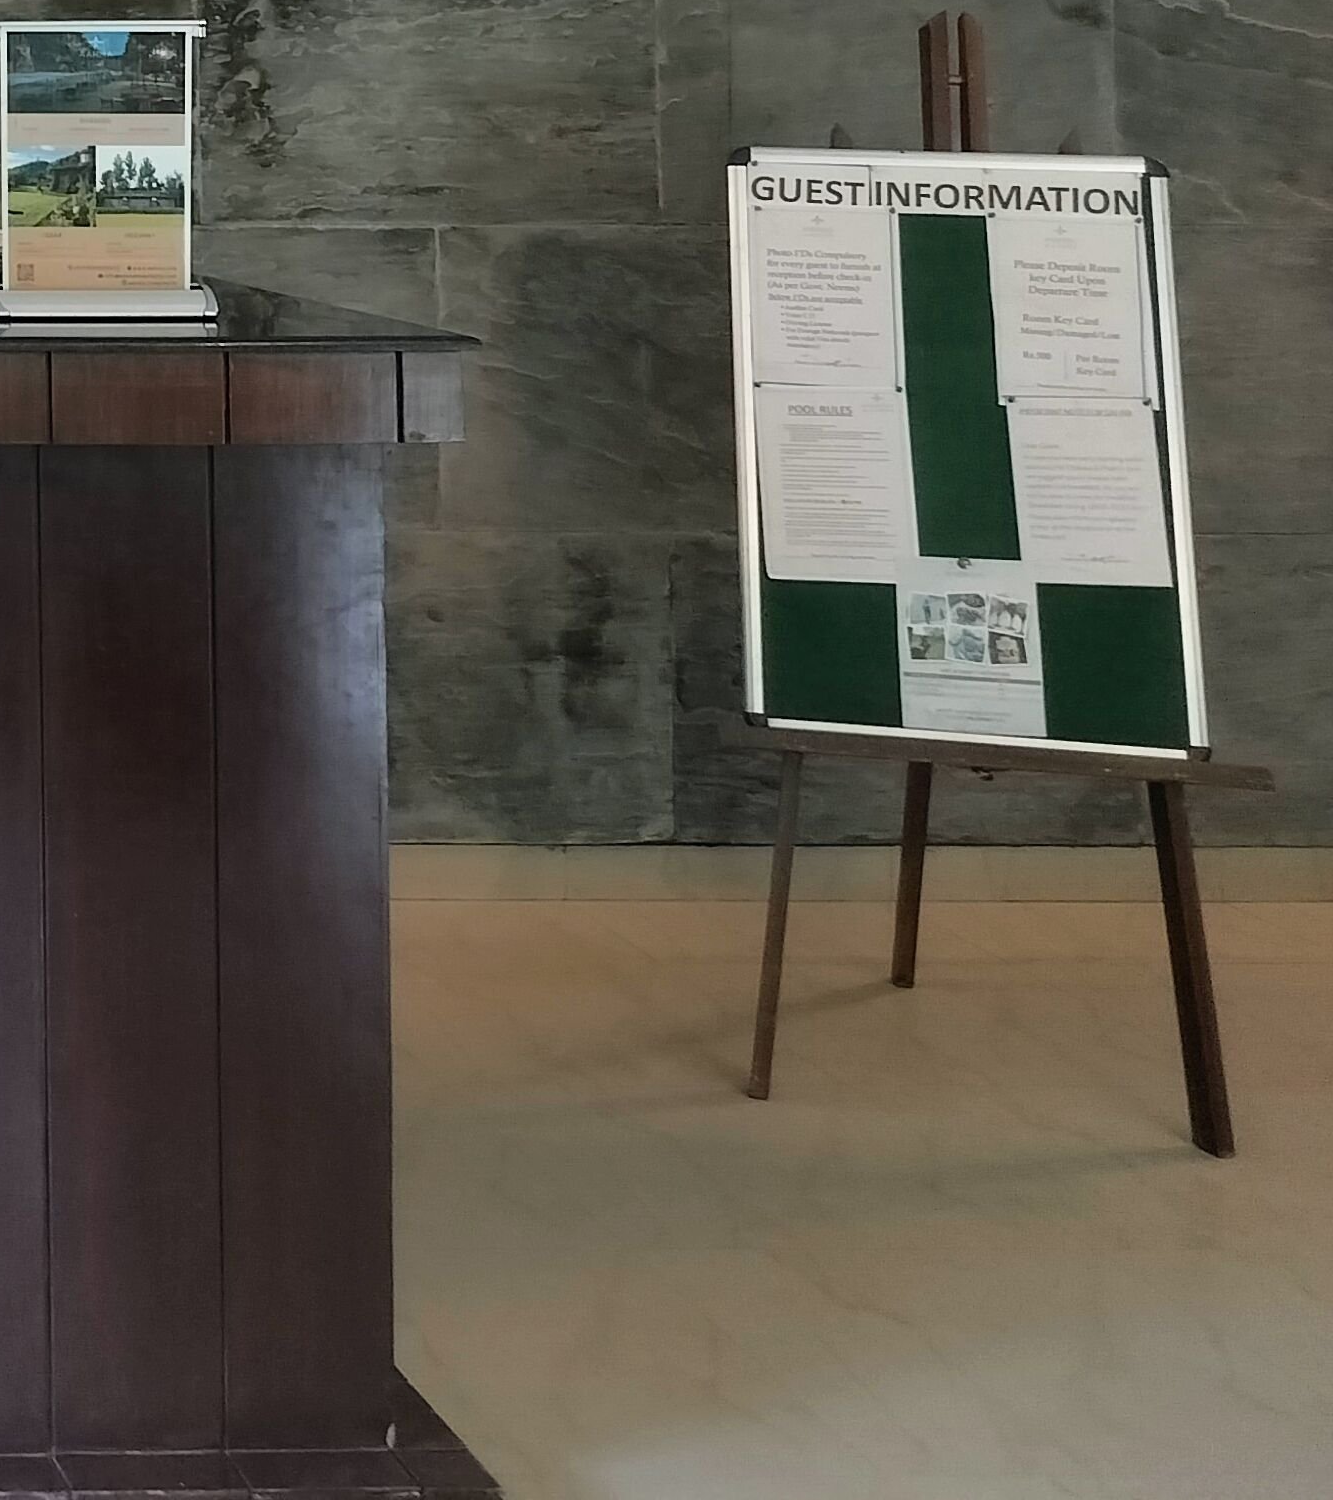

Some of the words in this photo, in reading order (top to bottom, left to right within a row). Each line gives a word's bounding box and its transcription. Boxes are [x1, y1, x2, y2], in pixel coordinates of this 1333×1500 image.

[751, 175, 865, 206] GUEST
[874, 181, 1140, 216] INFORMATION
[787, 404, 816, 415] POOL
[818, 405, 853, 417] RULES
